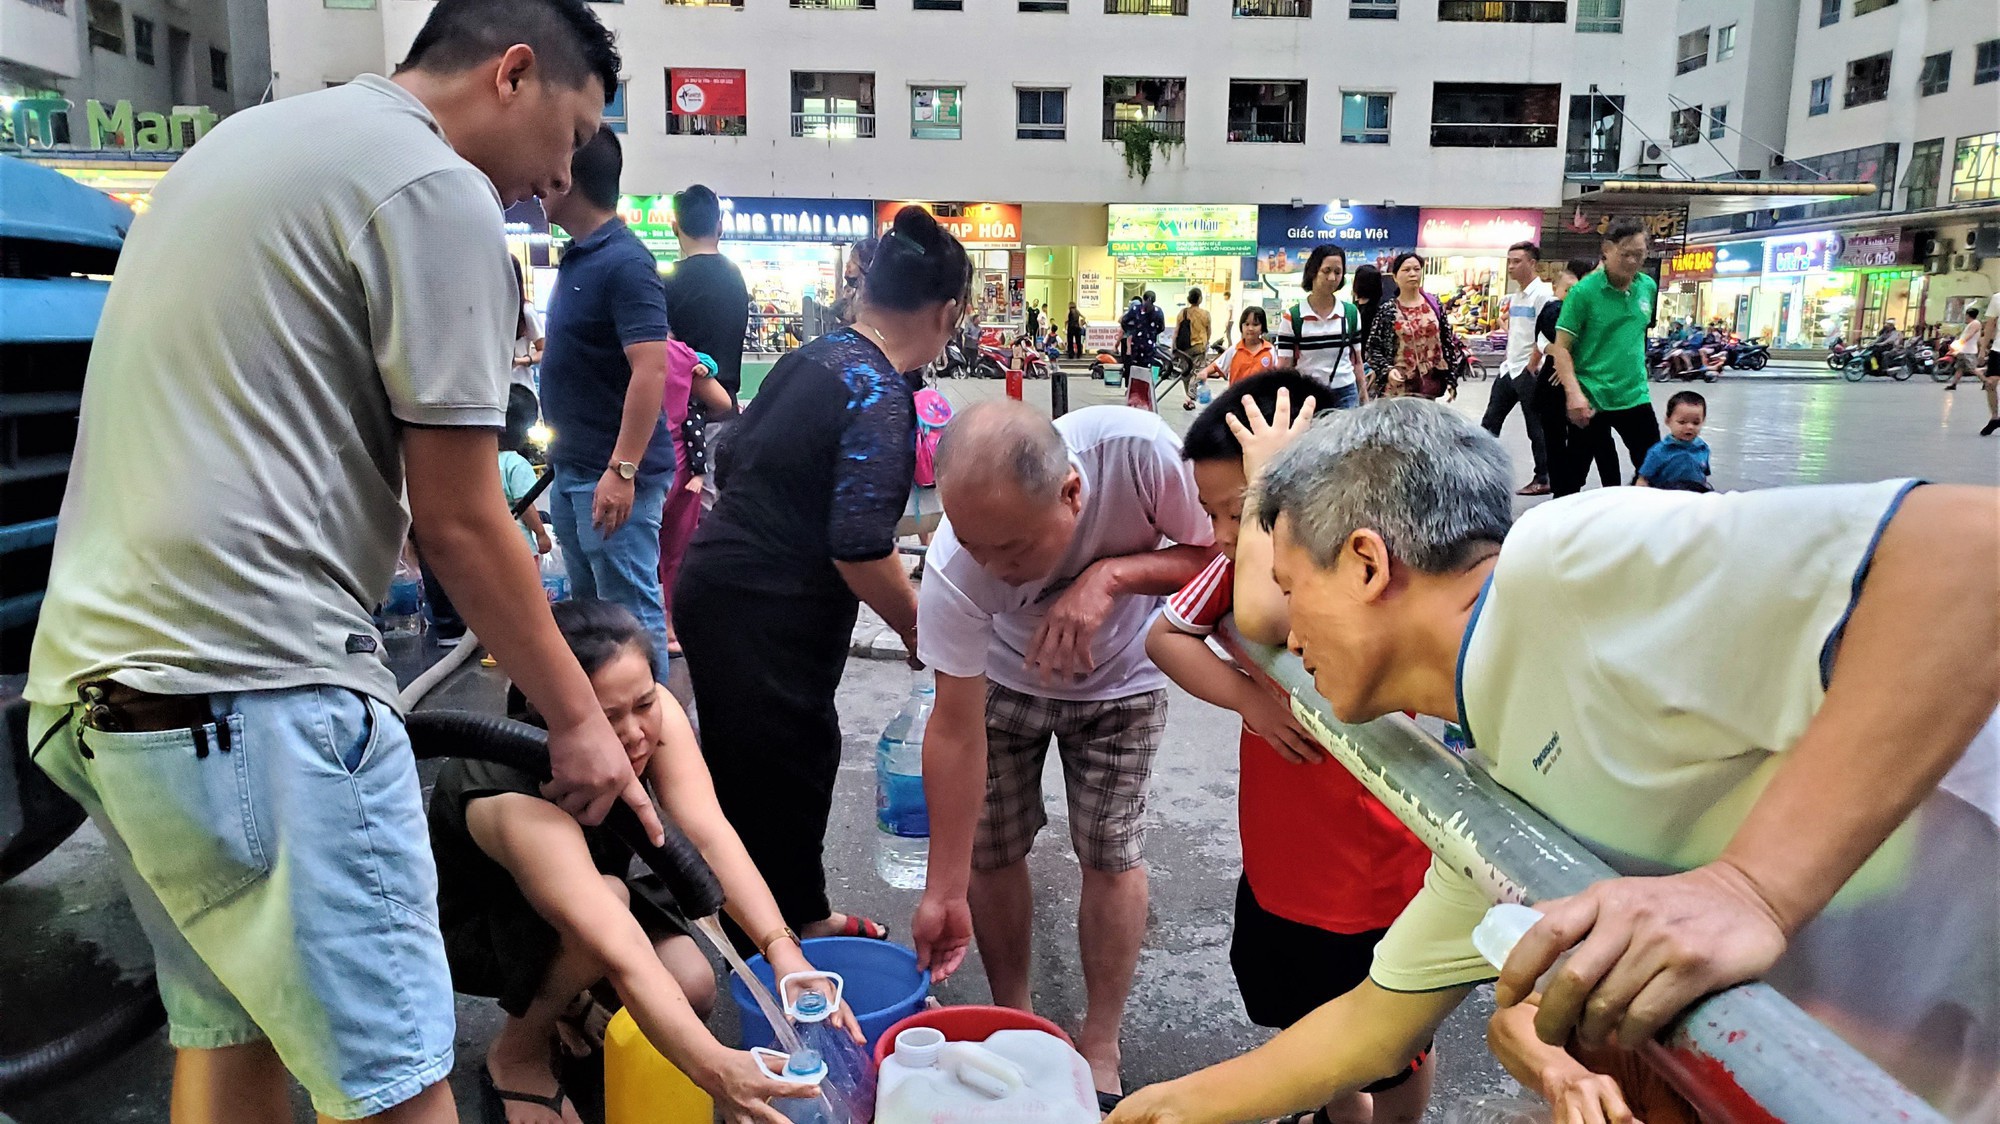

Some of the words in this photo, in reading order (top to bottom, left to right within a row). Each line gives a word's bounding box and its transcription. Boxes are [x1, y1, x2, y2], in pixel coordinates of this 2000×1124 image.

[87, 99, 217, 151] Mart
[825, 214, 868, 238] LAN
[978, 219, 1017, 238] HÓA
[1287, 225, 1314, 239] Giấc
[1339, 227, 1362, 239] sữa
[1364, 227, 1389, 241] Việt
[1532, 731, 1560, 771] Panasonic
